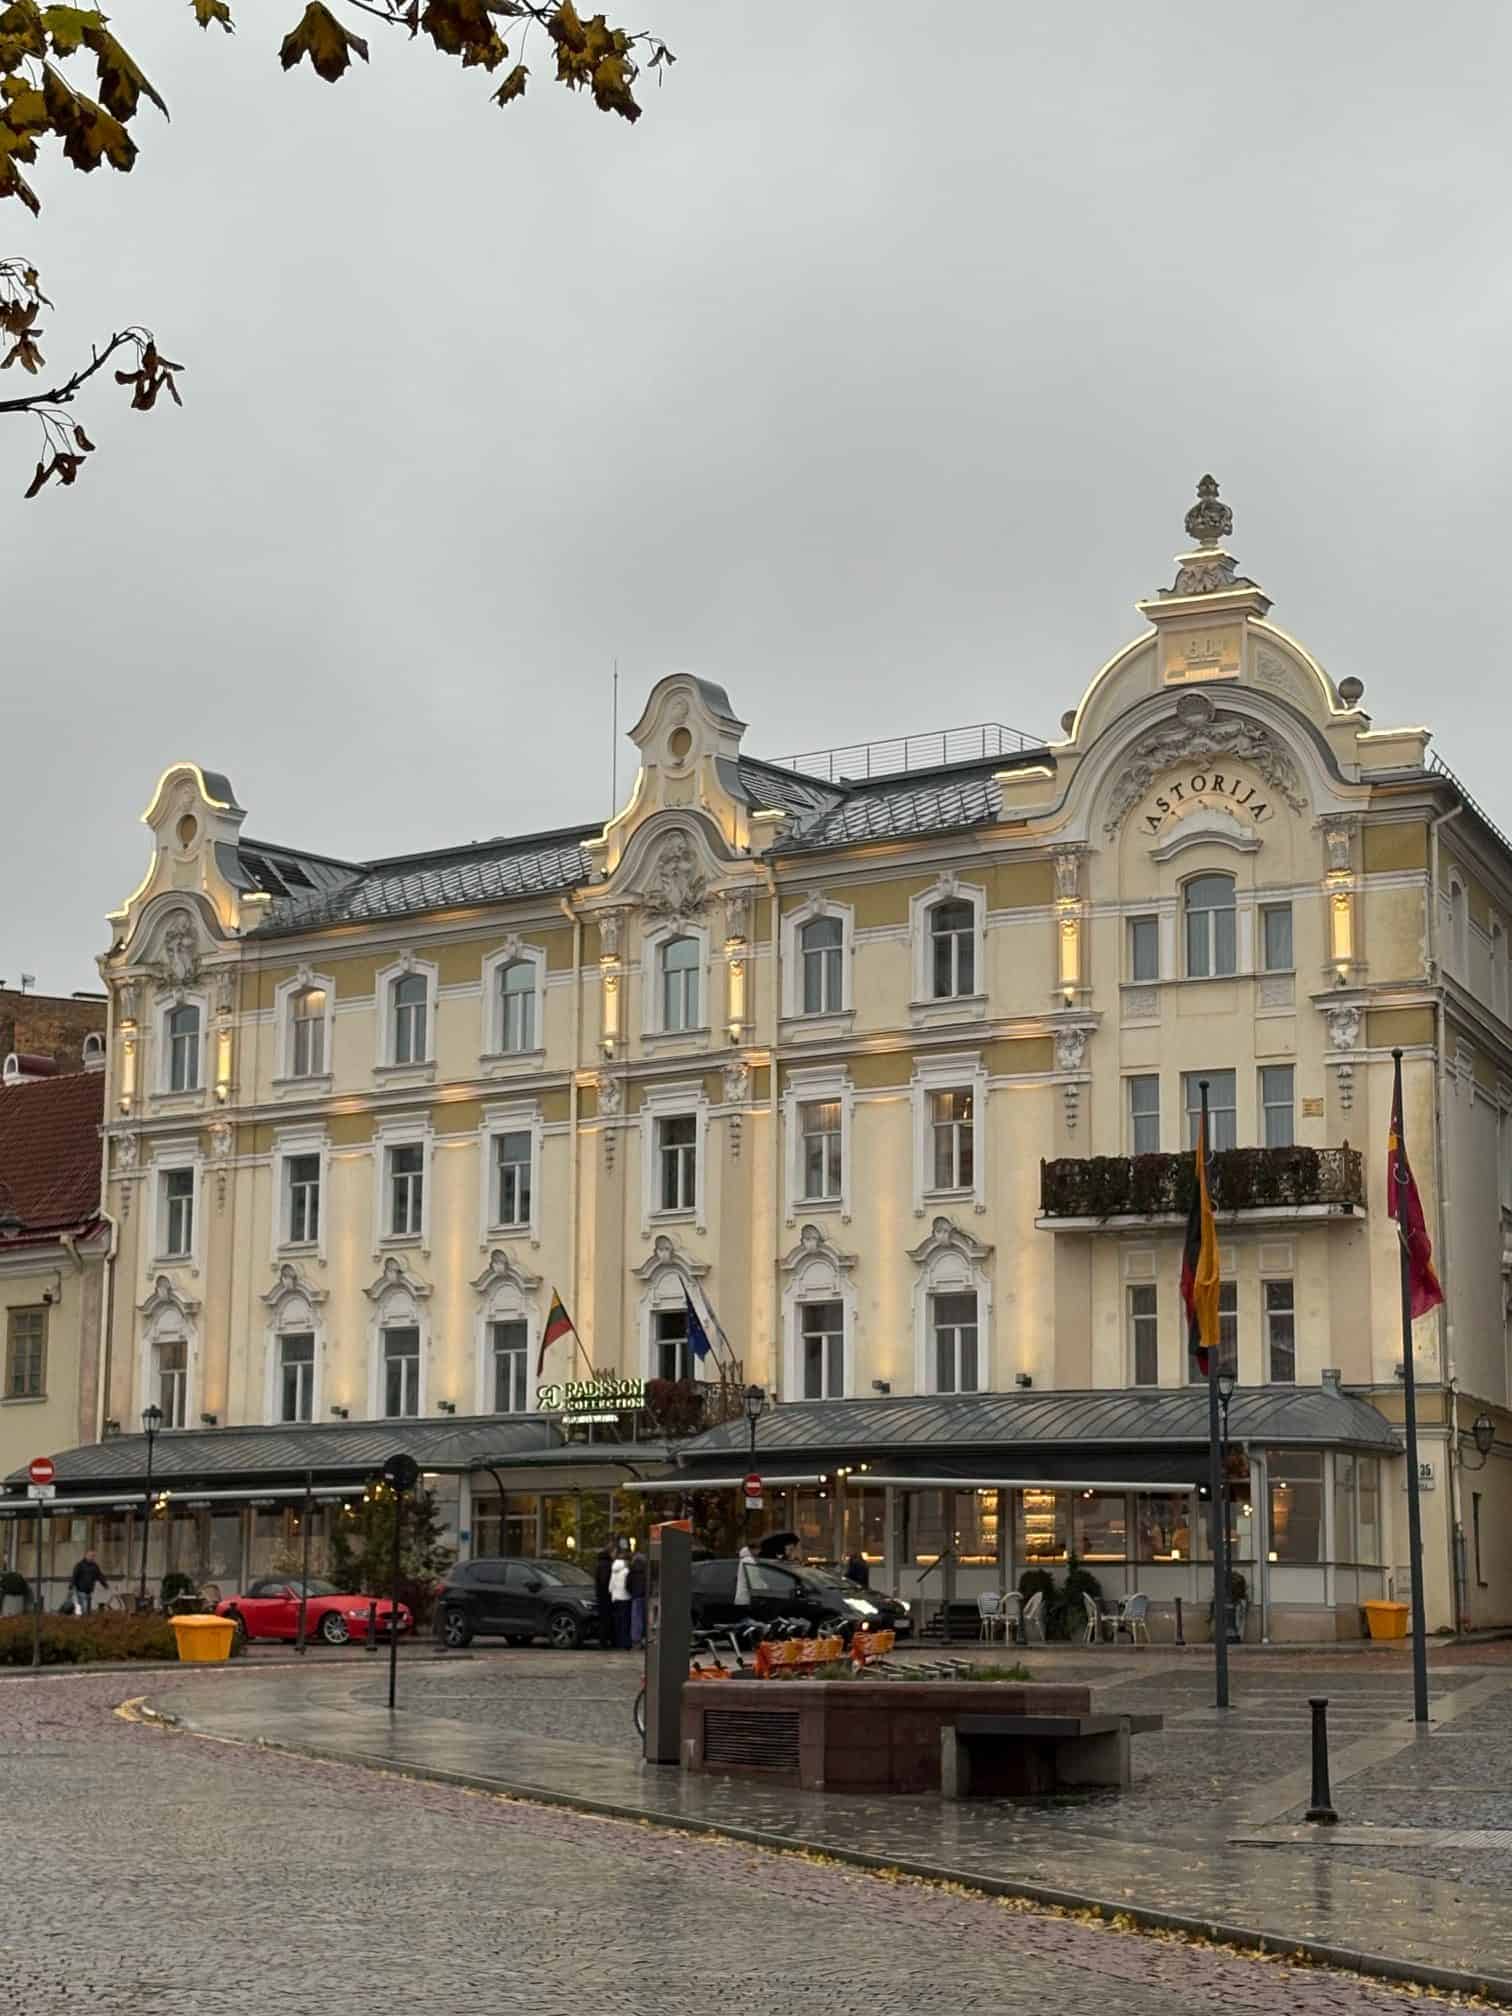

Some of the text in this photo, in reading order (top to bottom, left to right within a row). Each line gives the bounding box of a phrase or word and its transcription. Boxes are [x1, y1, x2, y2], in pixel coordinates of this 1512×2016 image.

[1145, 774, 1267, 830] ASTORIJA
[565, 1379, 645, 1399] RADISSON
[566, 1398, 645, 1411] COLLECTION
